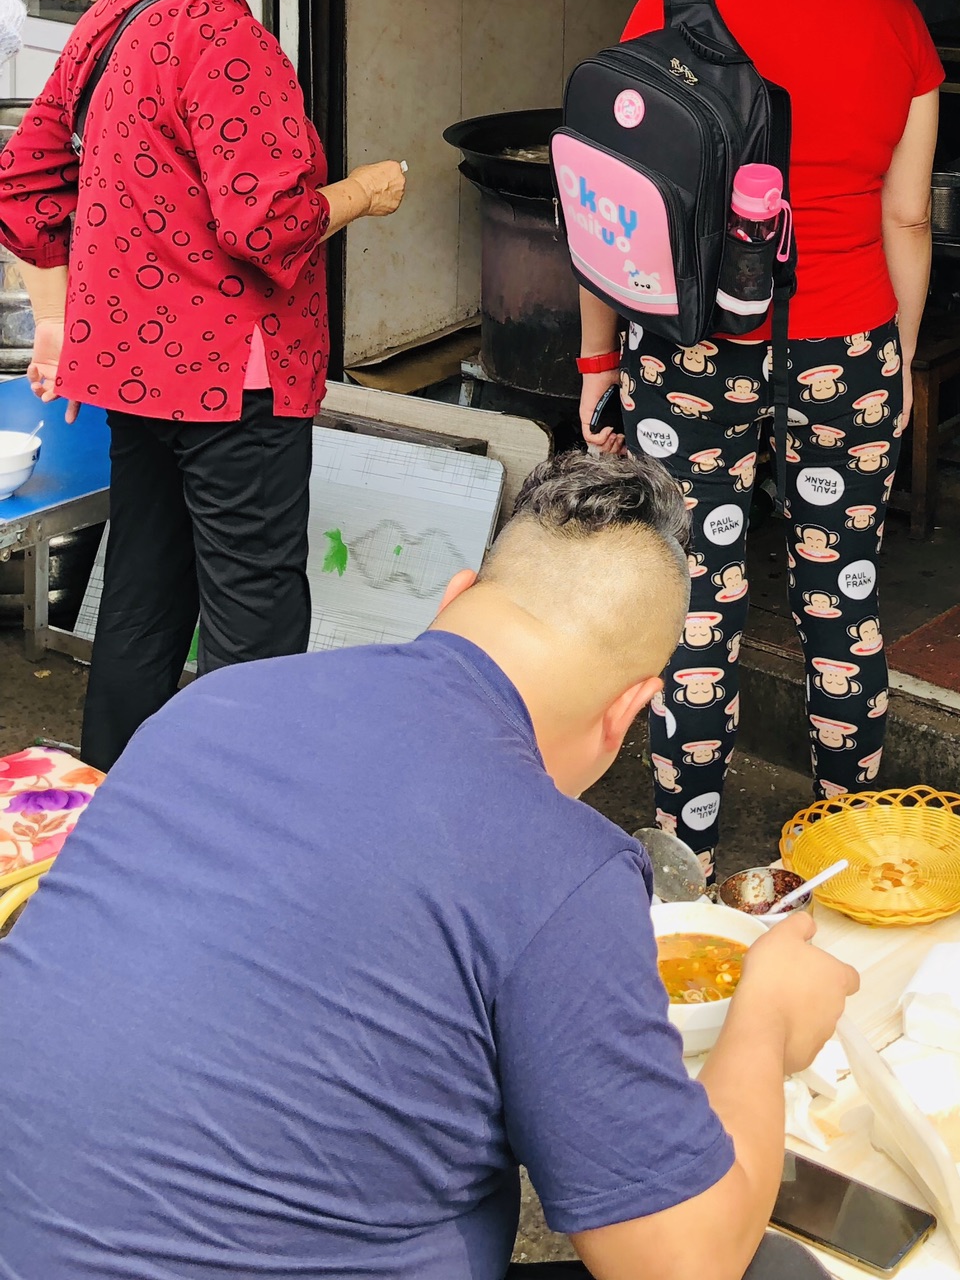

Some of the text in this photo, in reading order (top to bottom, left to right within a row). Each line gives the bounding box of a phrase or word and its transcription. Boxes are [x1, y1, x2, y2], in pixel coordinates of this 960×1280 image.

[559, 164, 637, 239] Okay
[804, 475, 837, 488] FRANK
[811, 484, 837, 495] PAUL
[709, 516, 733, 529] PAUL
[711, 519, 740, 536] FRANK
[845, 571, 867, 581] PAUL
[846, 576, 872, 589] FRANK
